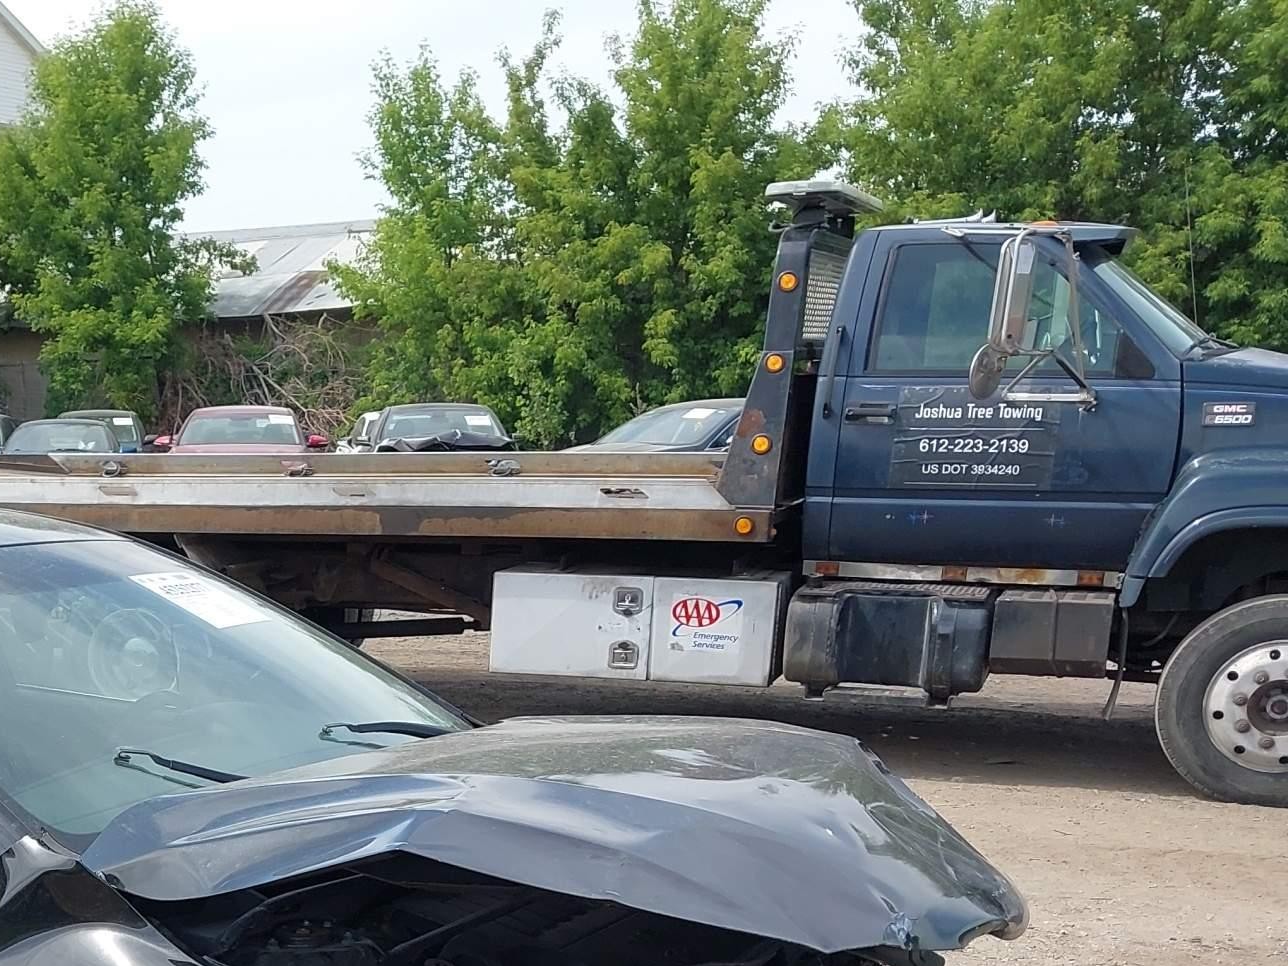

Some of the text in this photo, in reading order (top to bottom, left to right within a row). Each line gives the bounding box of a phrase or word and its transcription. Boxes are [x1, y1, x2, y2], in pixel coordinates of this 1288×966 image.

[915, 403, 1043, 421] Joshua Tree Towing
[1213, 405, 1248, 413] GMC
[919, 438, 1029, 453] 612-223-2139
[922, 464, 1020, 475] US DOT 3934240
[674, 599, 718, 627] AAA
[693, 632, 739, 643] Emergency
[692, 641, 725, 650] Services
